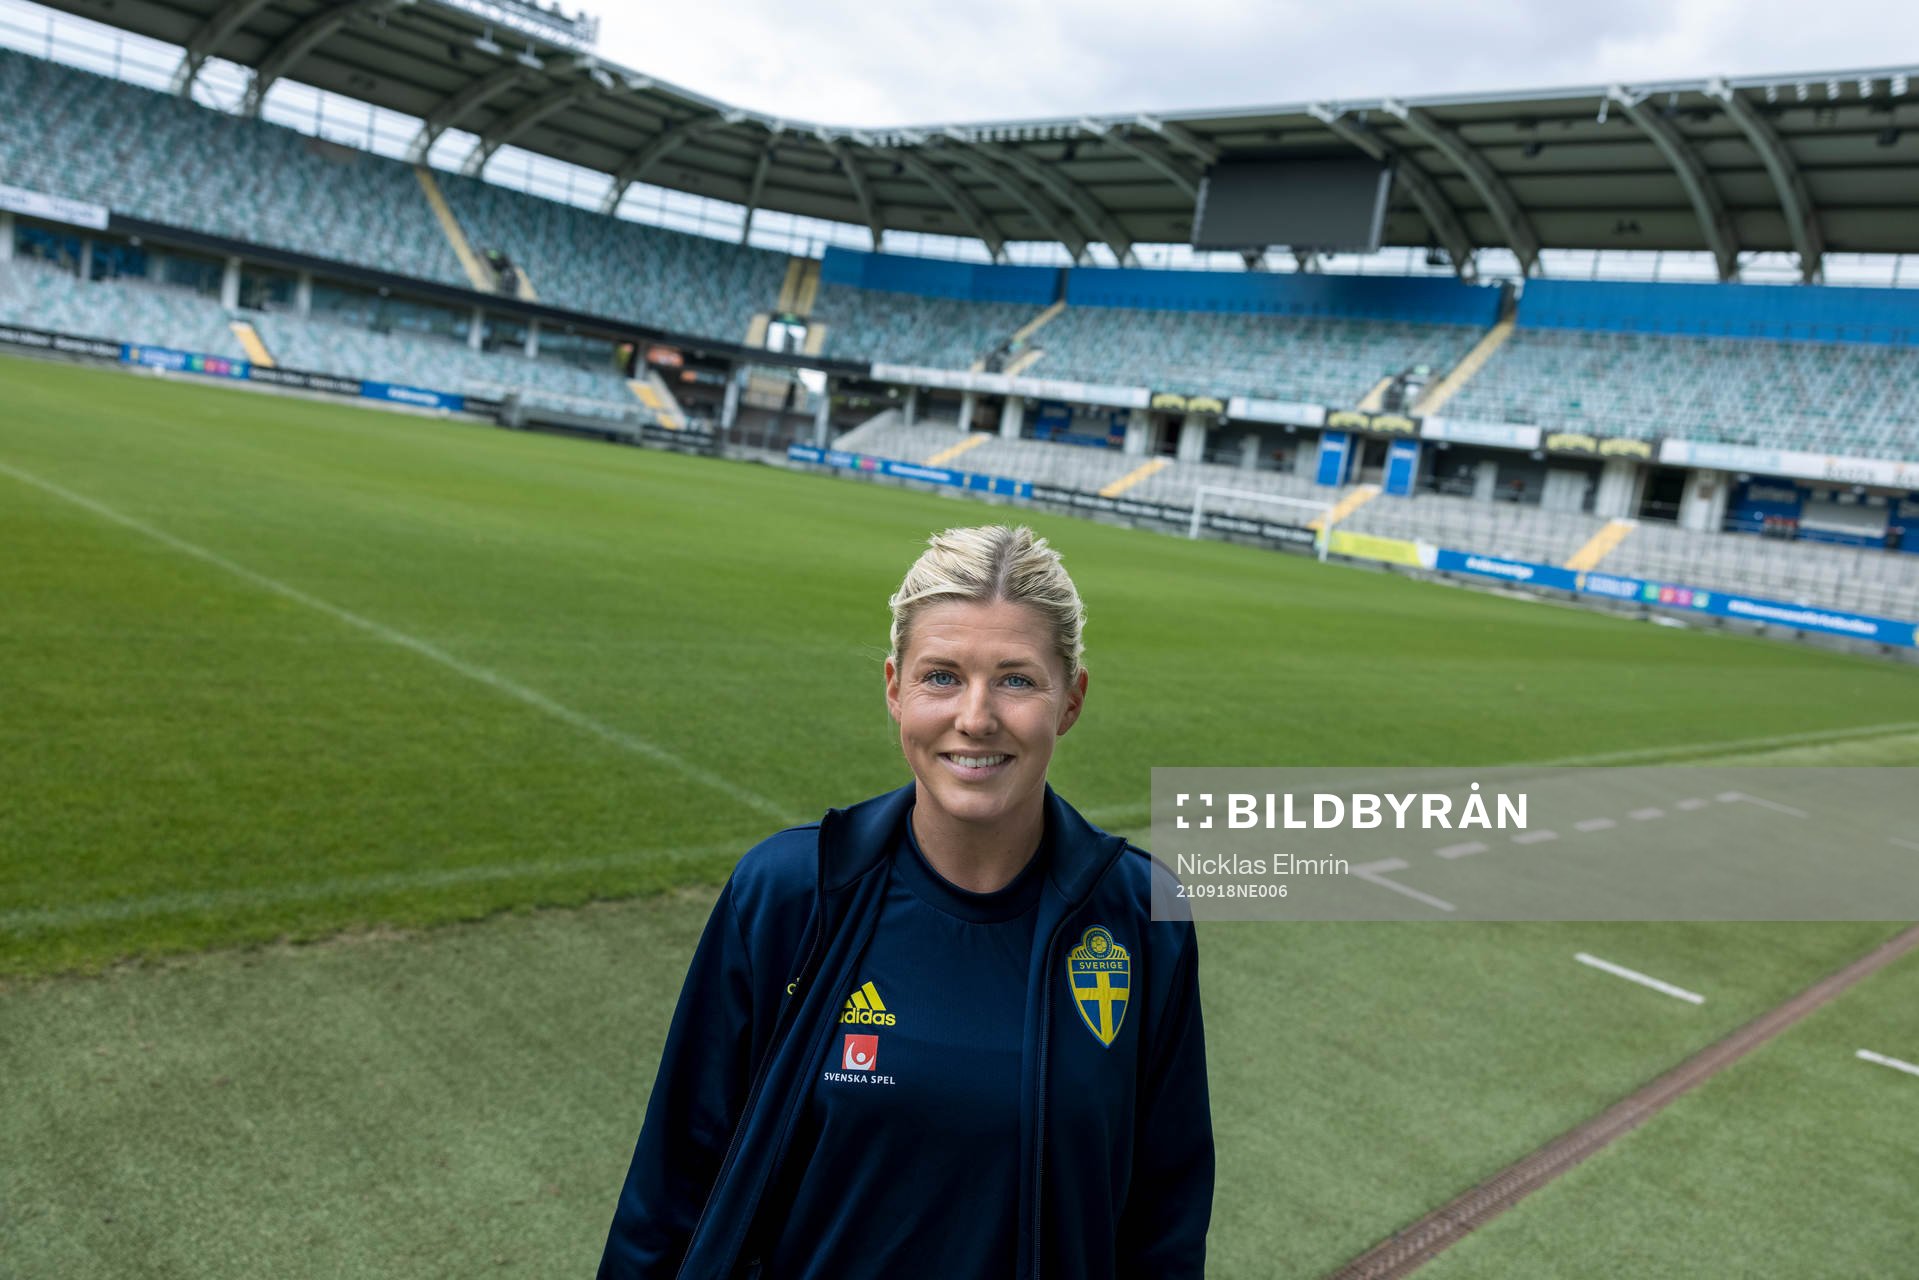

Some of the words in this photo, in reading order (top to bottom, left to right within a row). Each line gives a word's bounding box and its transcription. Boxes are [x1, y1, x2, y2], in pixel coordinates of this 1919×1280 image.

[1079, 961, 1123, 970] SVERIGE
[824, 1072, 868, 1084] SVENSKA
[870, 1075, 896, 1085] SPEL
